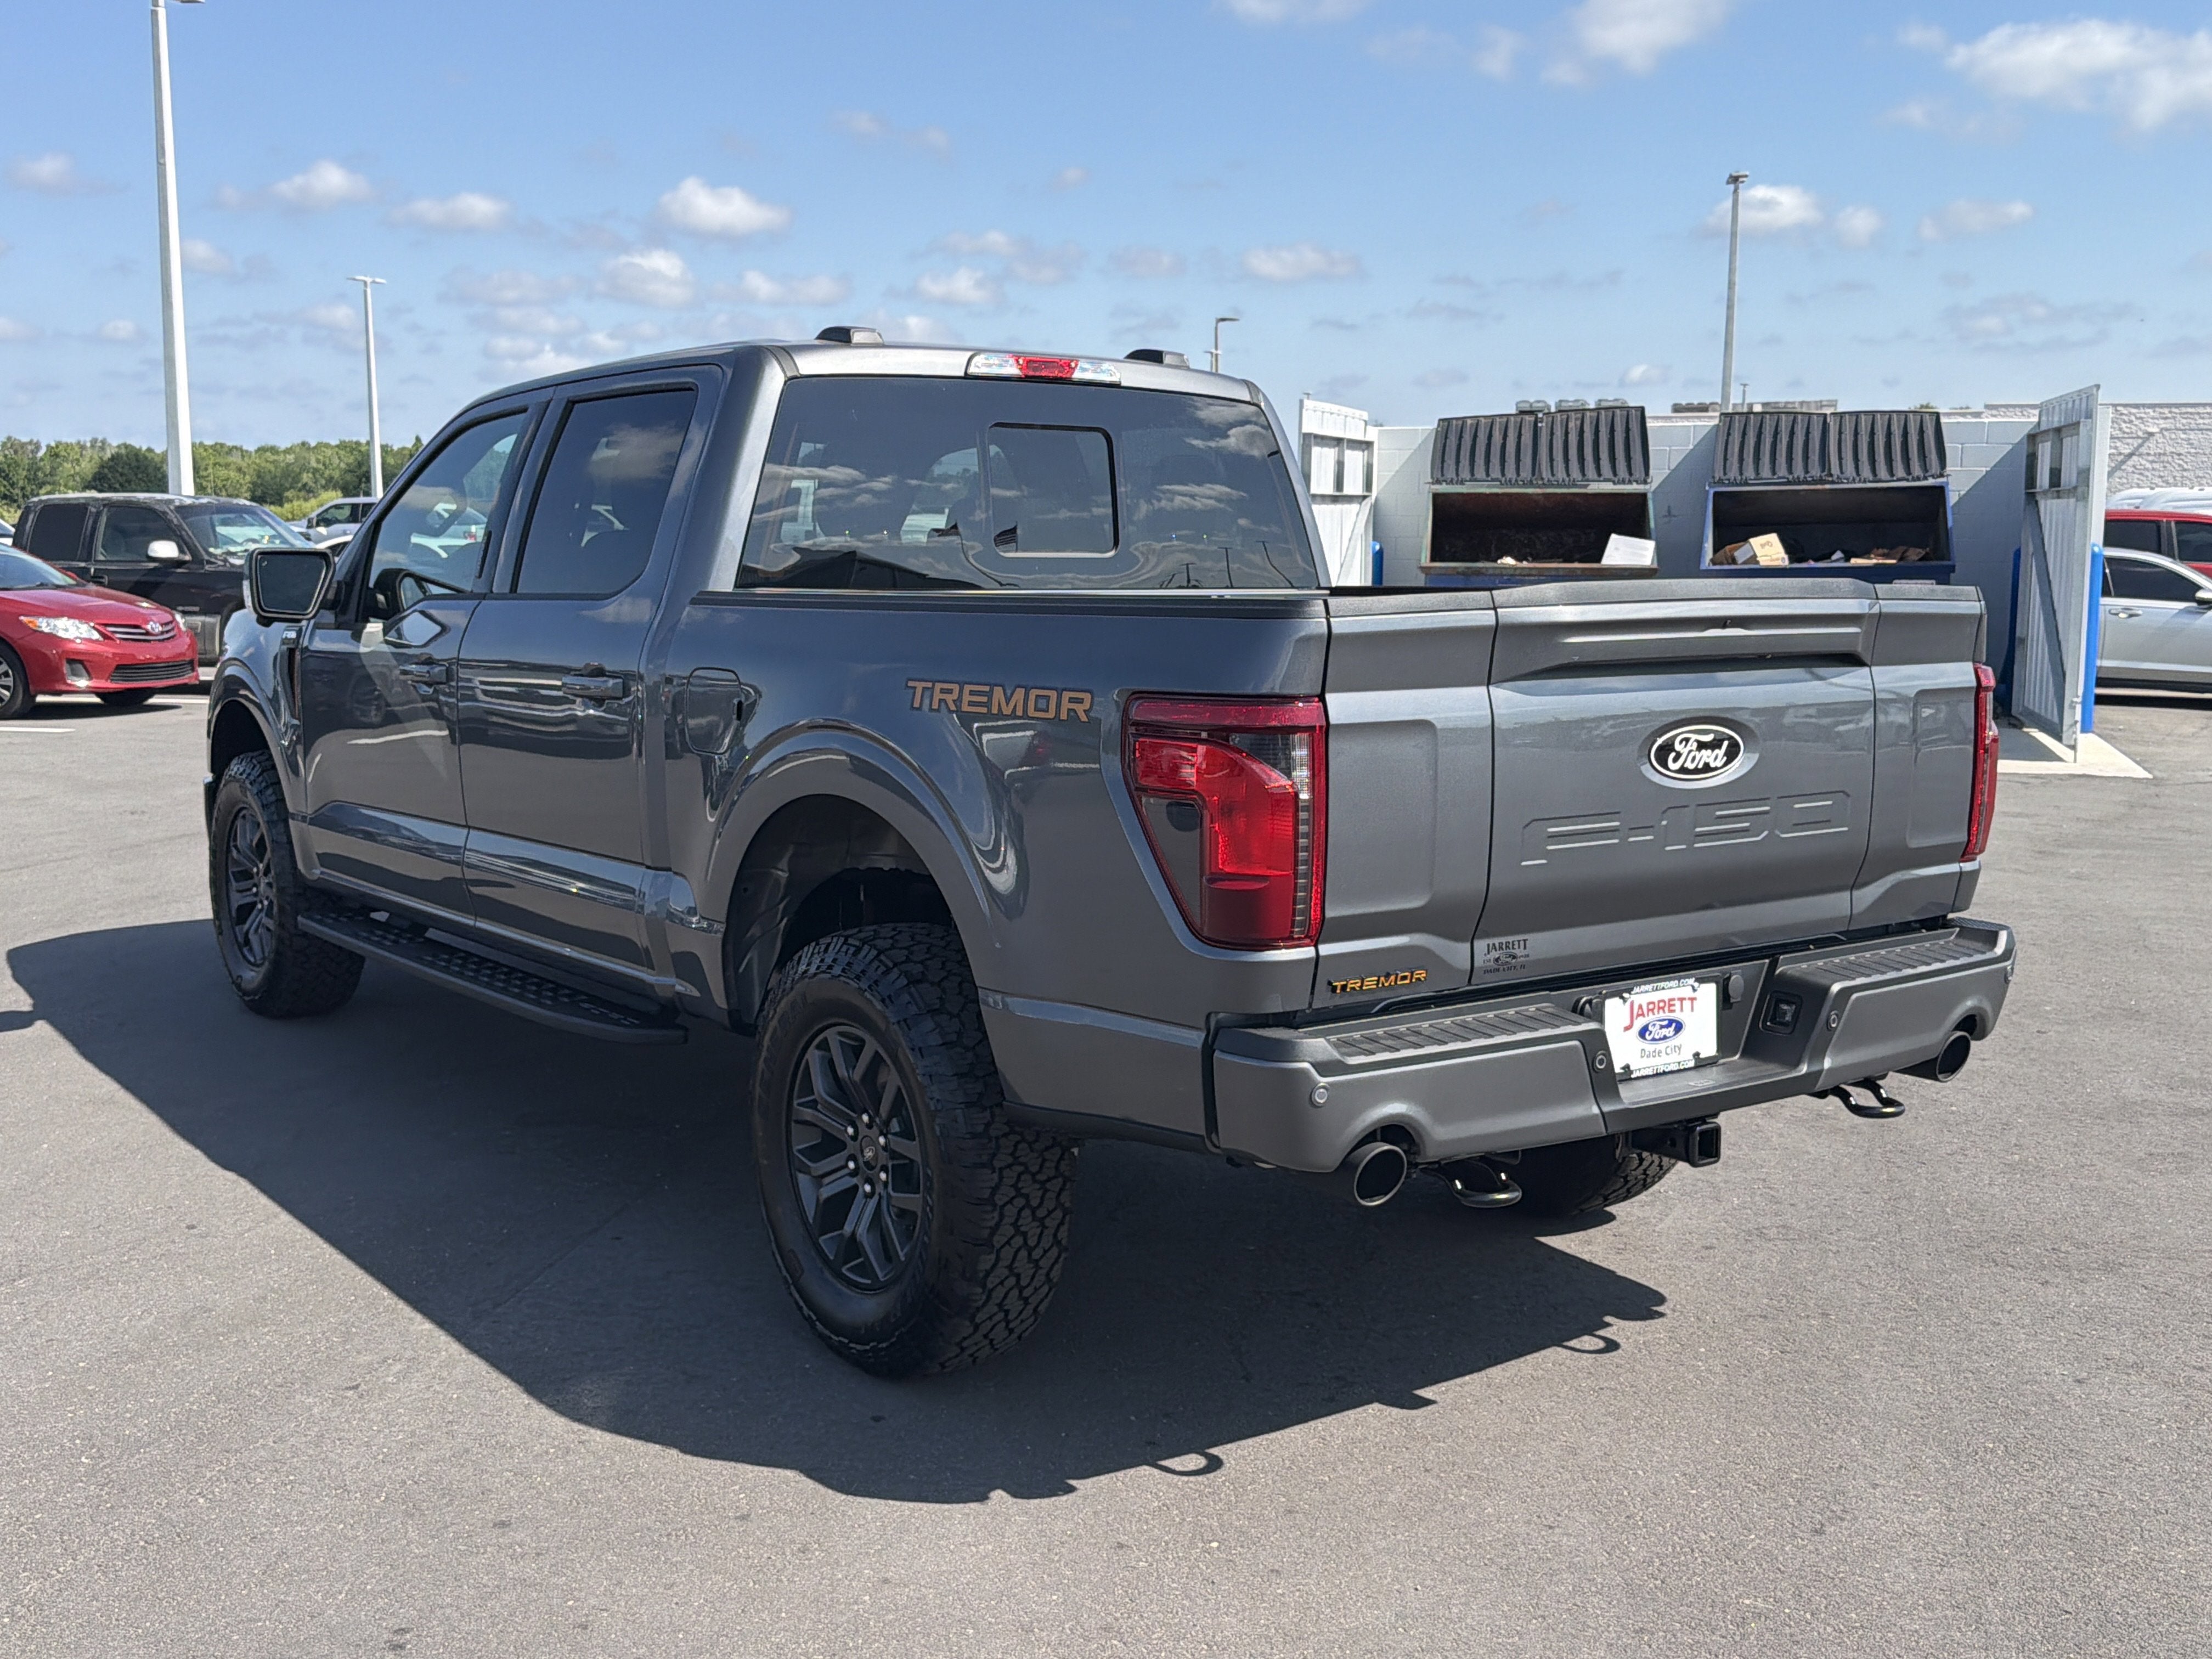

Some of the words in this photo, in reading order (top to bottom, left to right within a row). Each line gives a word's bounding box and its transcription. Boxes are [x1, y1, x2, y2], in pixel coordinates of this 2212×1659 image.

[906, 680, 1092, 723] TREMOR
[1667, 733, 1729, 771] Ford
[1521, 791, 1850, 865] F-150
[1484, 938, 1528, 956] JARRETT
[1330, 969, 1427, 994] TREMOR
[1623, 996, 1697, 1032] JARRETT
[1645, 1020, 1676, 1040] Ford
[1640, 1048, 1662, 1059] Dade
[1664, 1044, 1683, 1056] City
[1630, 1059, 1695, 1079] JARRETTFORD.COM
